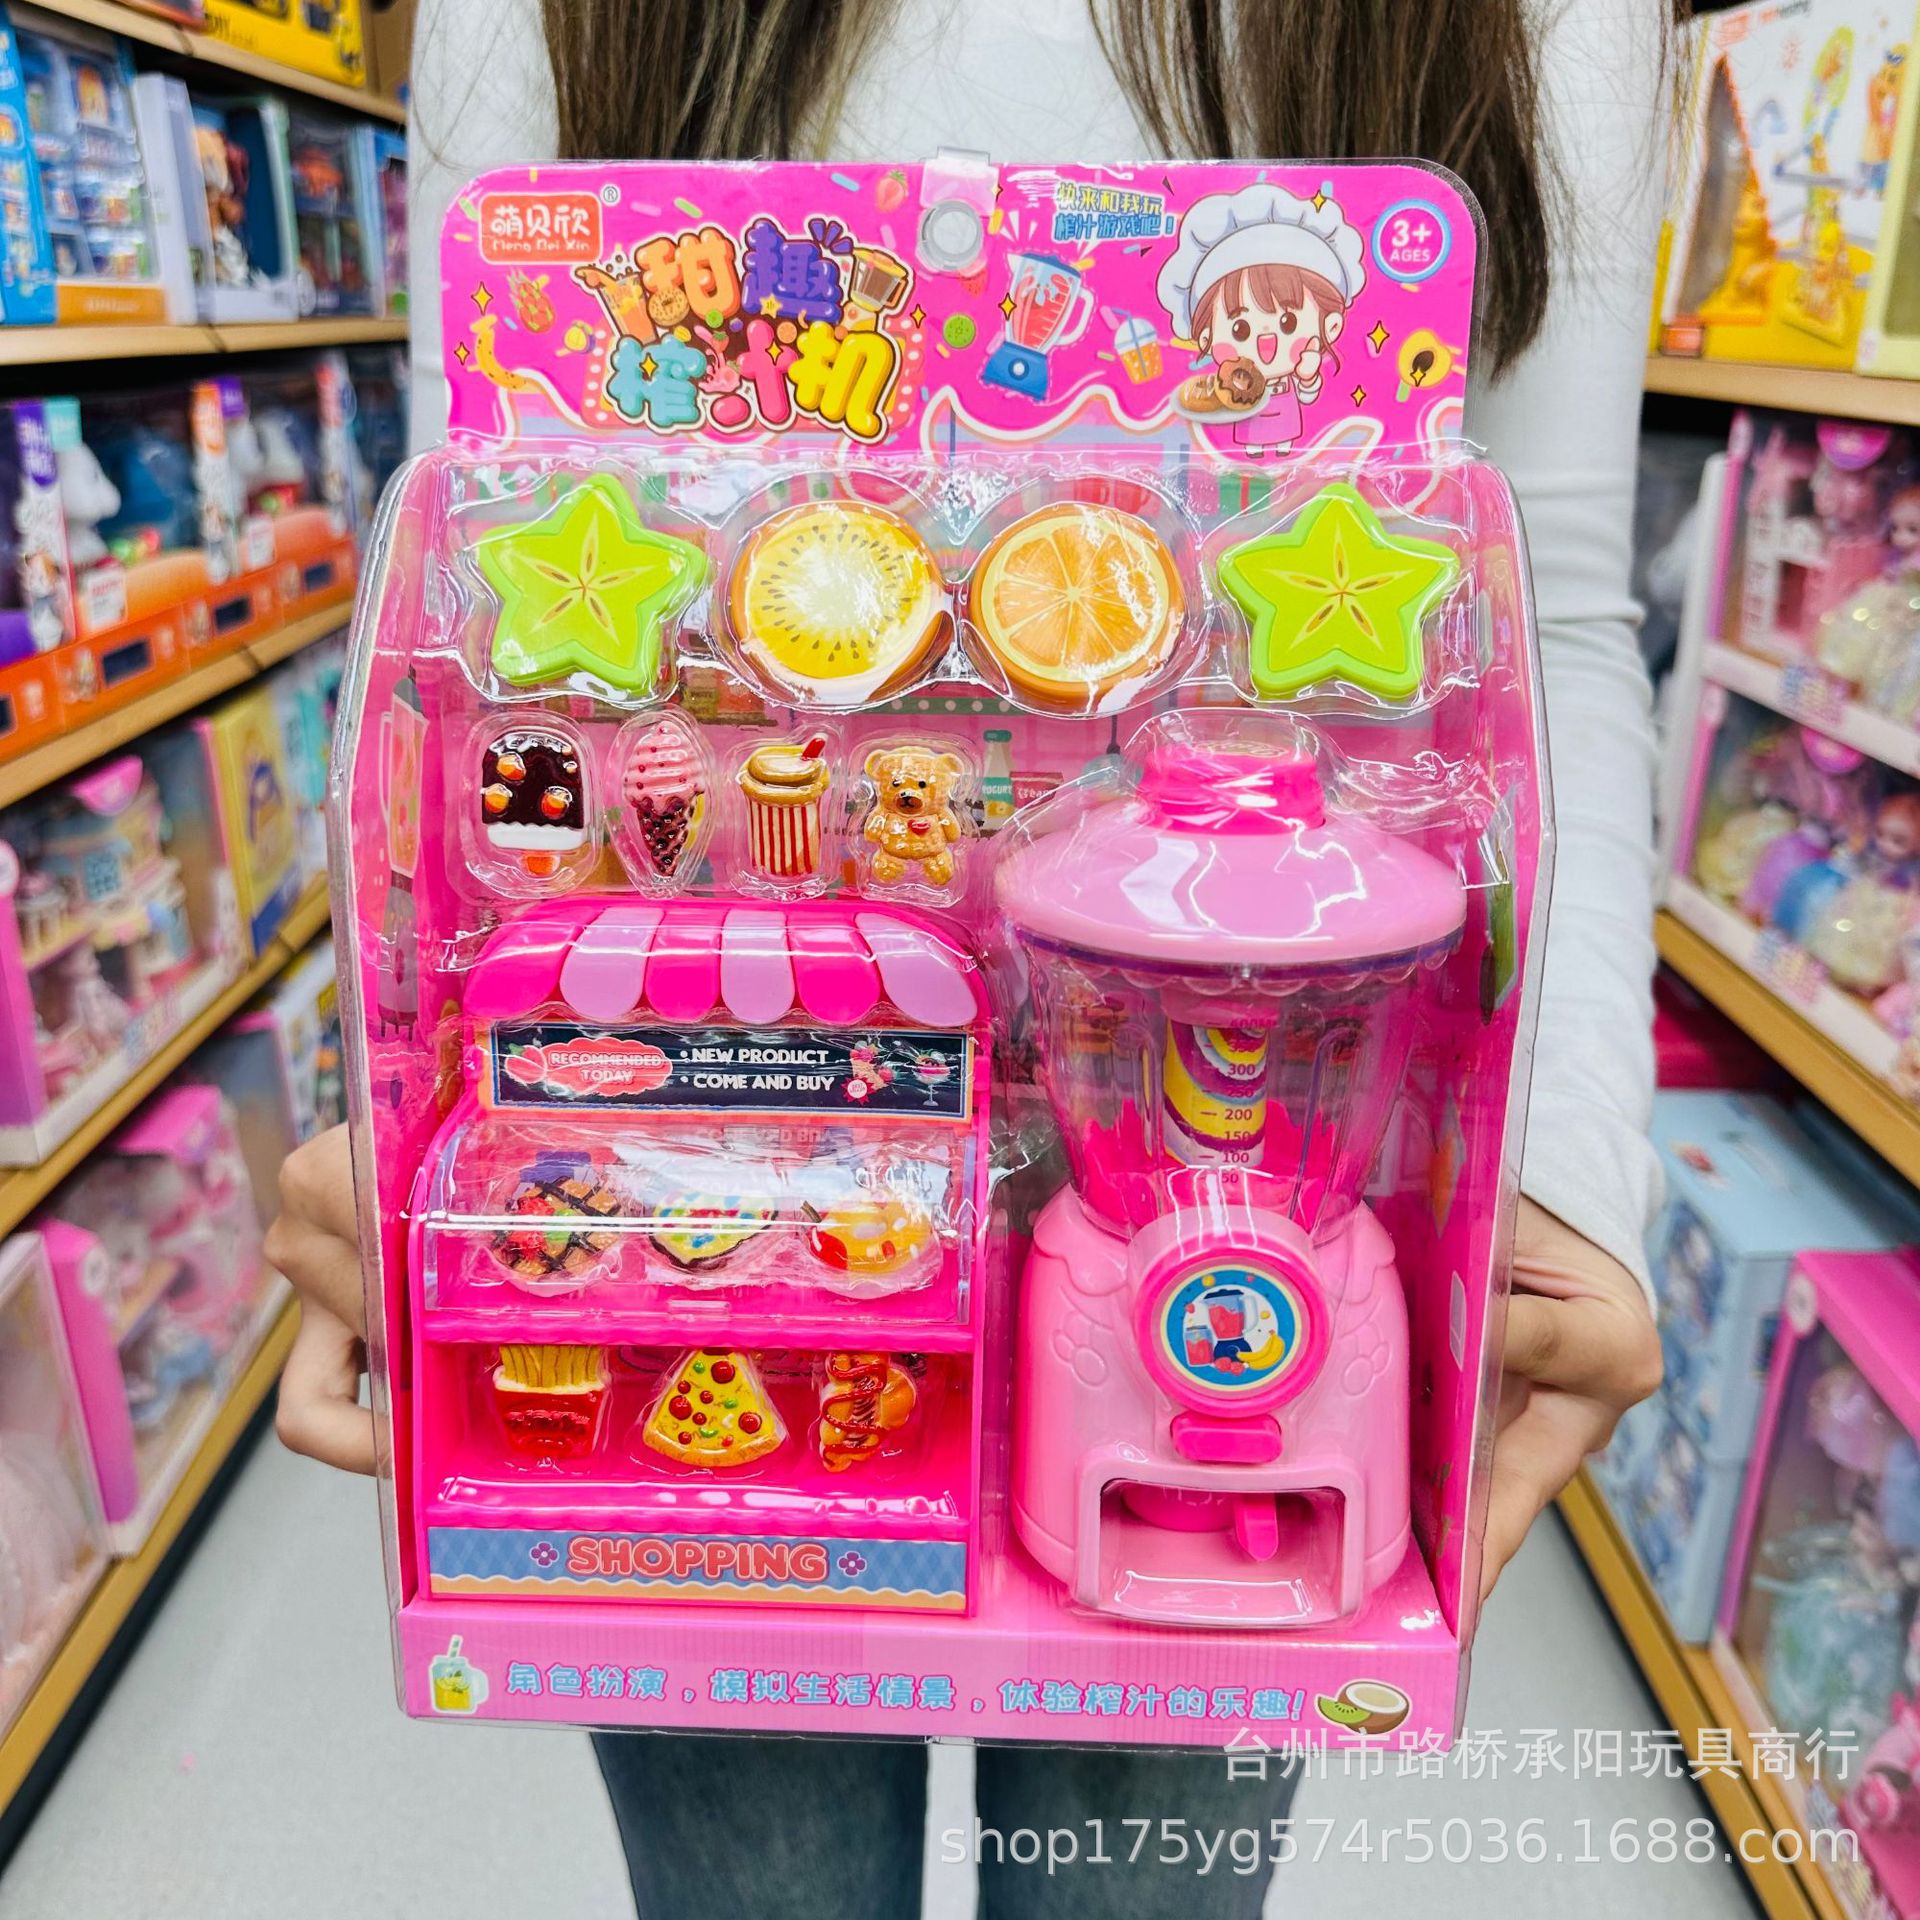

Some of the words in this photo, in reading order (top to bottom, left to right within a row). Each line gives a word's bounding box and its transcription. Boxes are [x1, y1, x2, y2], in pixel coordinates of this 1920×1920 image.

[1057, 182, 1162, 215] 快来和我玩
[490, 203, 591, 239] 萌贝欣
[1391, 219, 1432, 248] 3+
[565, 238, 590, 250] Xin
[1390, 248, 1431, 262] AGES
[634, 217, 845, 323] 甜趣
[607, 318, 897, 438] 榨汁机
[550, 1052, 664, 1068] RECOMMENDED
[692, 1048, 733, 1065] NEW
[738, 1049, 829, 1066] PRODUCT
[581, 1069, 634, 1084] TODAY
[1228, 1063, 1256, 1076] 300
[693, 1073, 751, 1090] COME
[751, 1075, 794, 1091] AND
[796, 1076, 835, 1092] BUY
[1228, 1087, 1254, 1099] 250
[1225, 1108, 1253, 1121] 200
[1224, 1130, 1251, 1141] 150
[1223, 1151, 1249, 1164] 100
[1221, 1172, 1239, 1184] 50
[567, 1537, 829, 1583] SHOPPING
